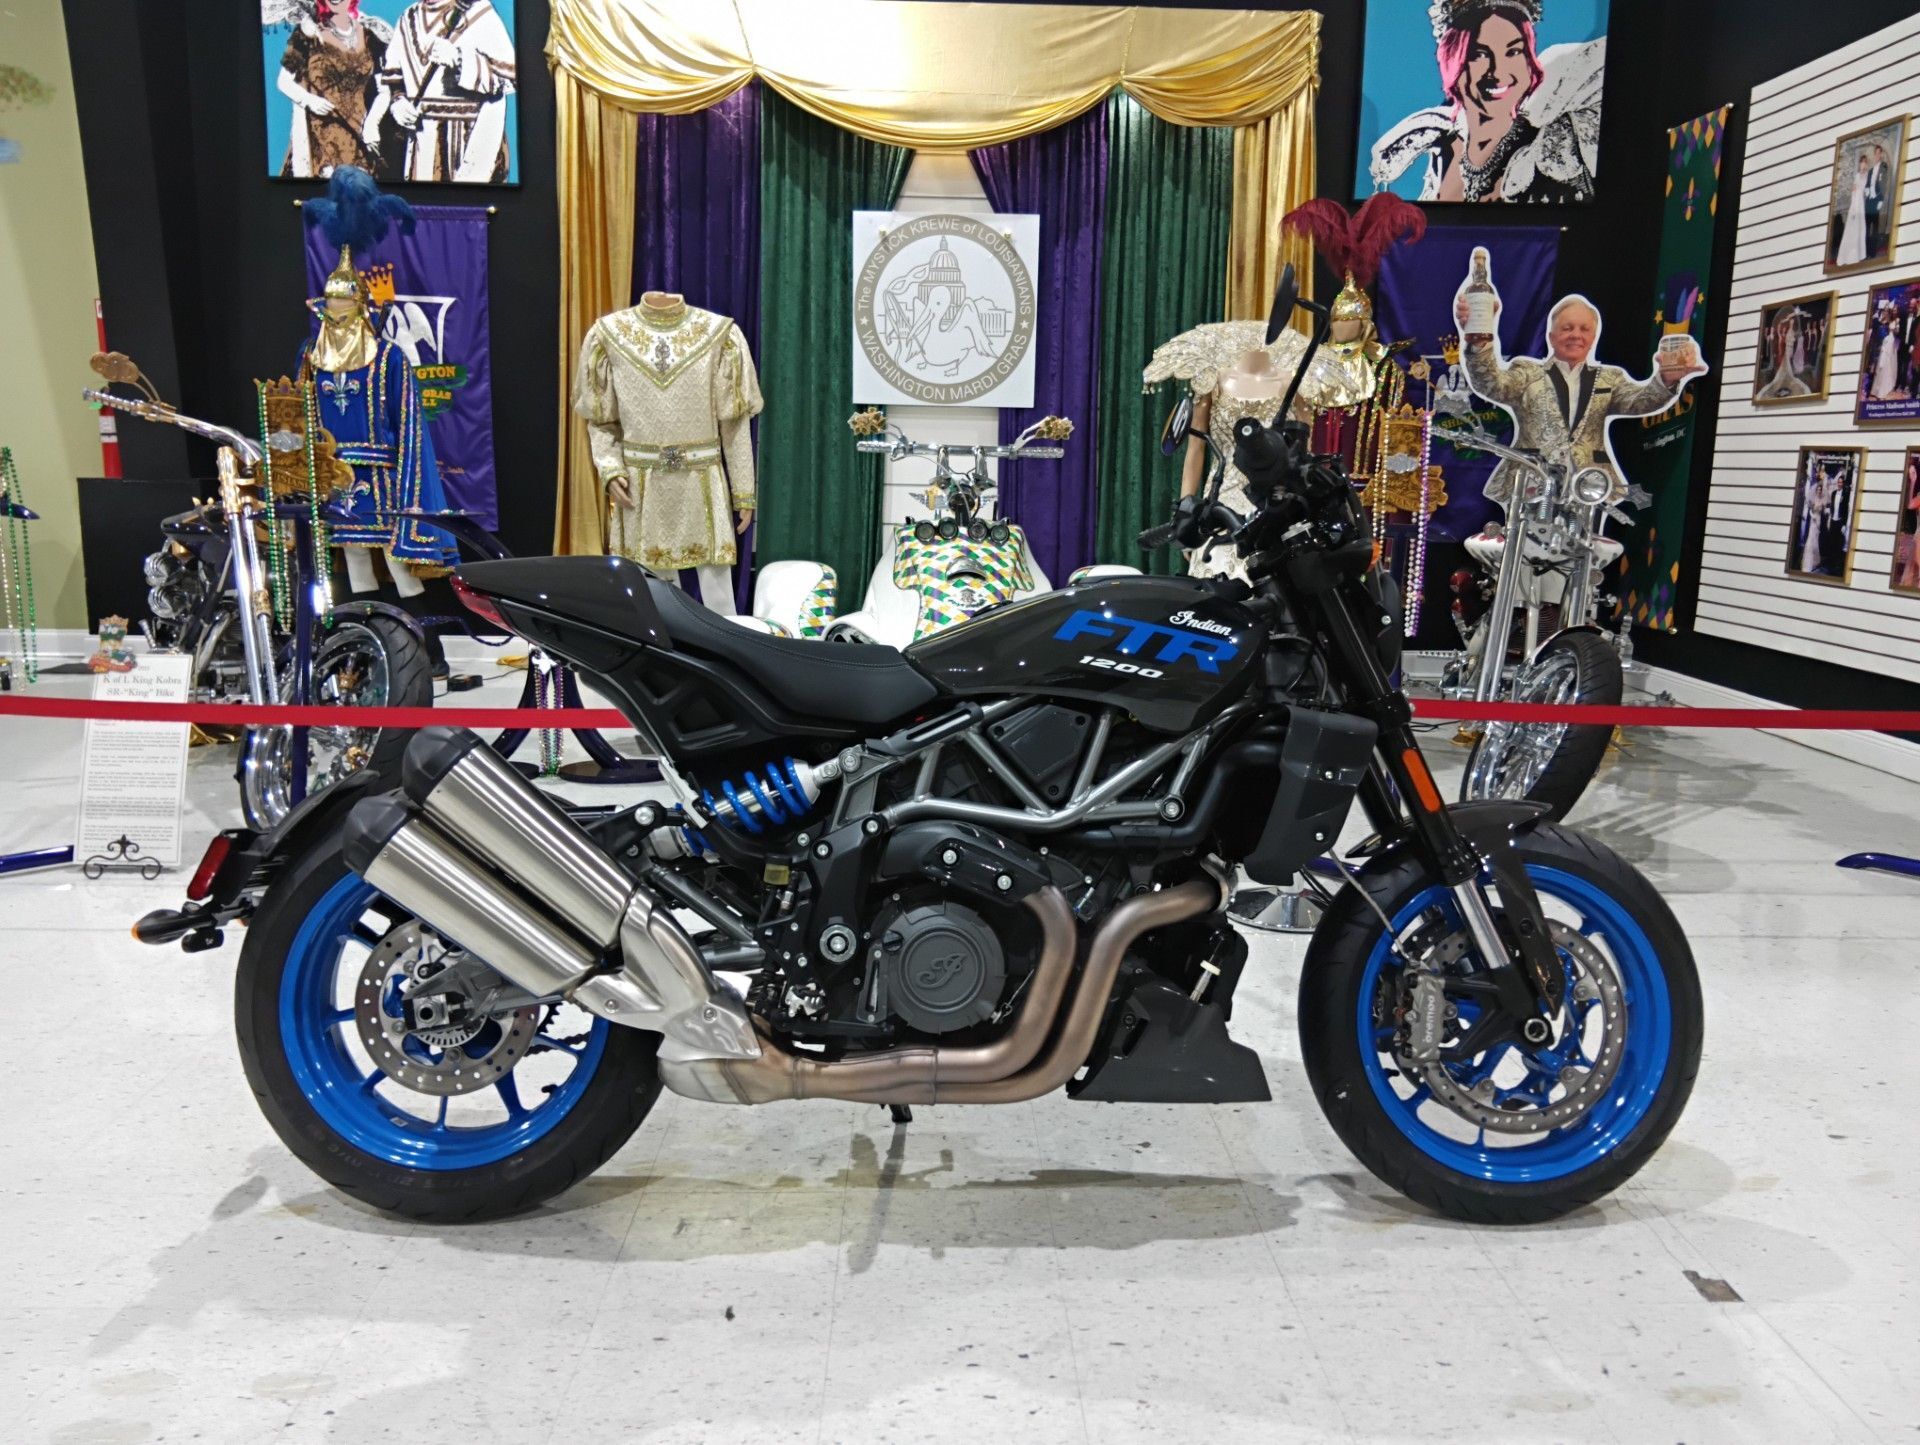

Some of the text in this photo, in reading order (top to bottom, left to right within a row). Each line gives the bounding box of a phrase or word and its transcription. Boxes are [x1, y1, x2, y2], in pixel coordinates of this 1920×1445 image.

[858, 218, 1032, 315] The MYSTICK KREWE of LOUISIANIANS
[413, 366, 456, 379] GTON
[862, 329, 1027, 400] WASHINGTON MARDI GRAS
[1053, 609, 1240, 674] FTR
[1169, 610, 1233, 637] Indian
[1079, 655, 1164, 679] 1200
